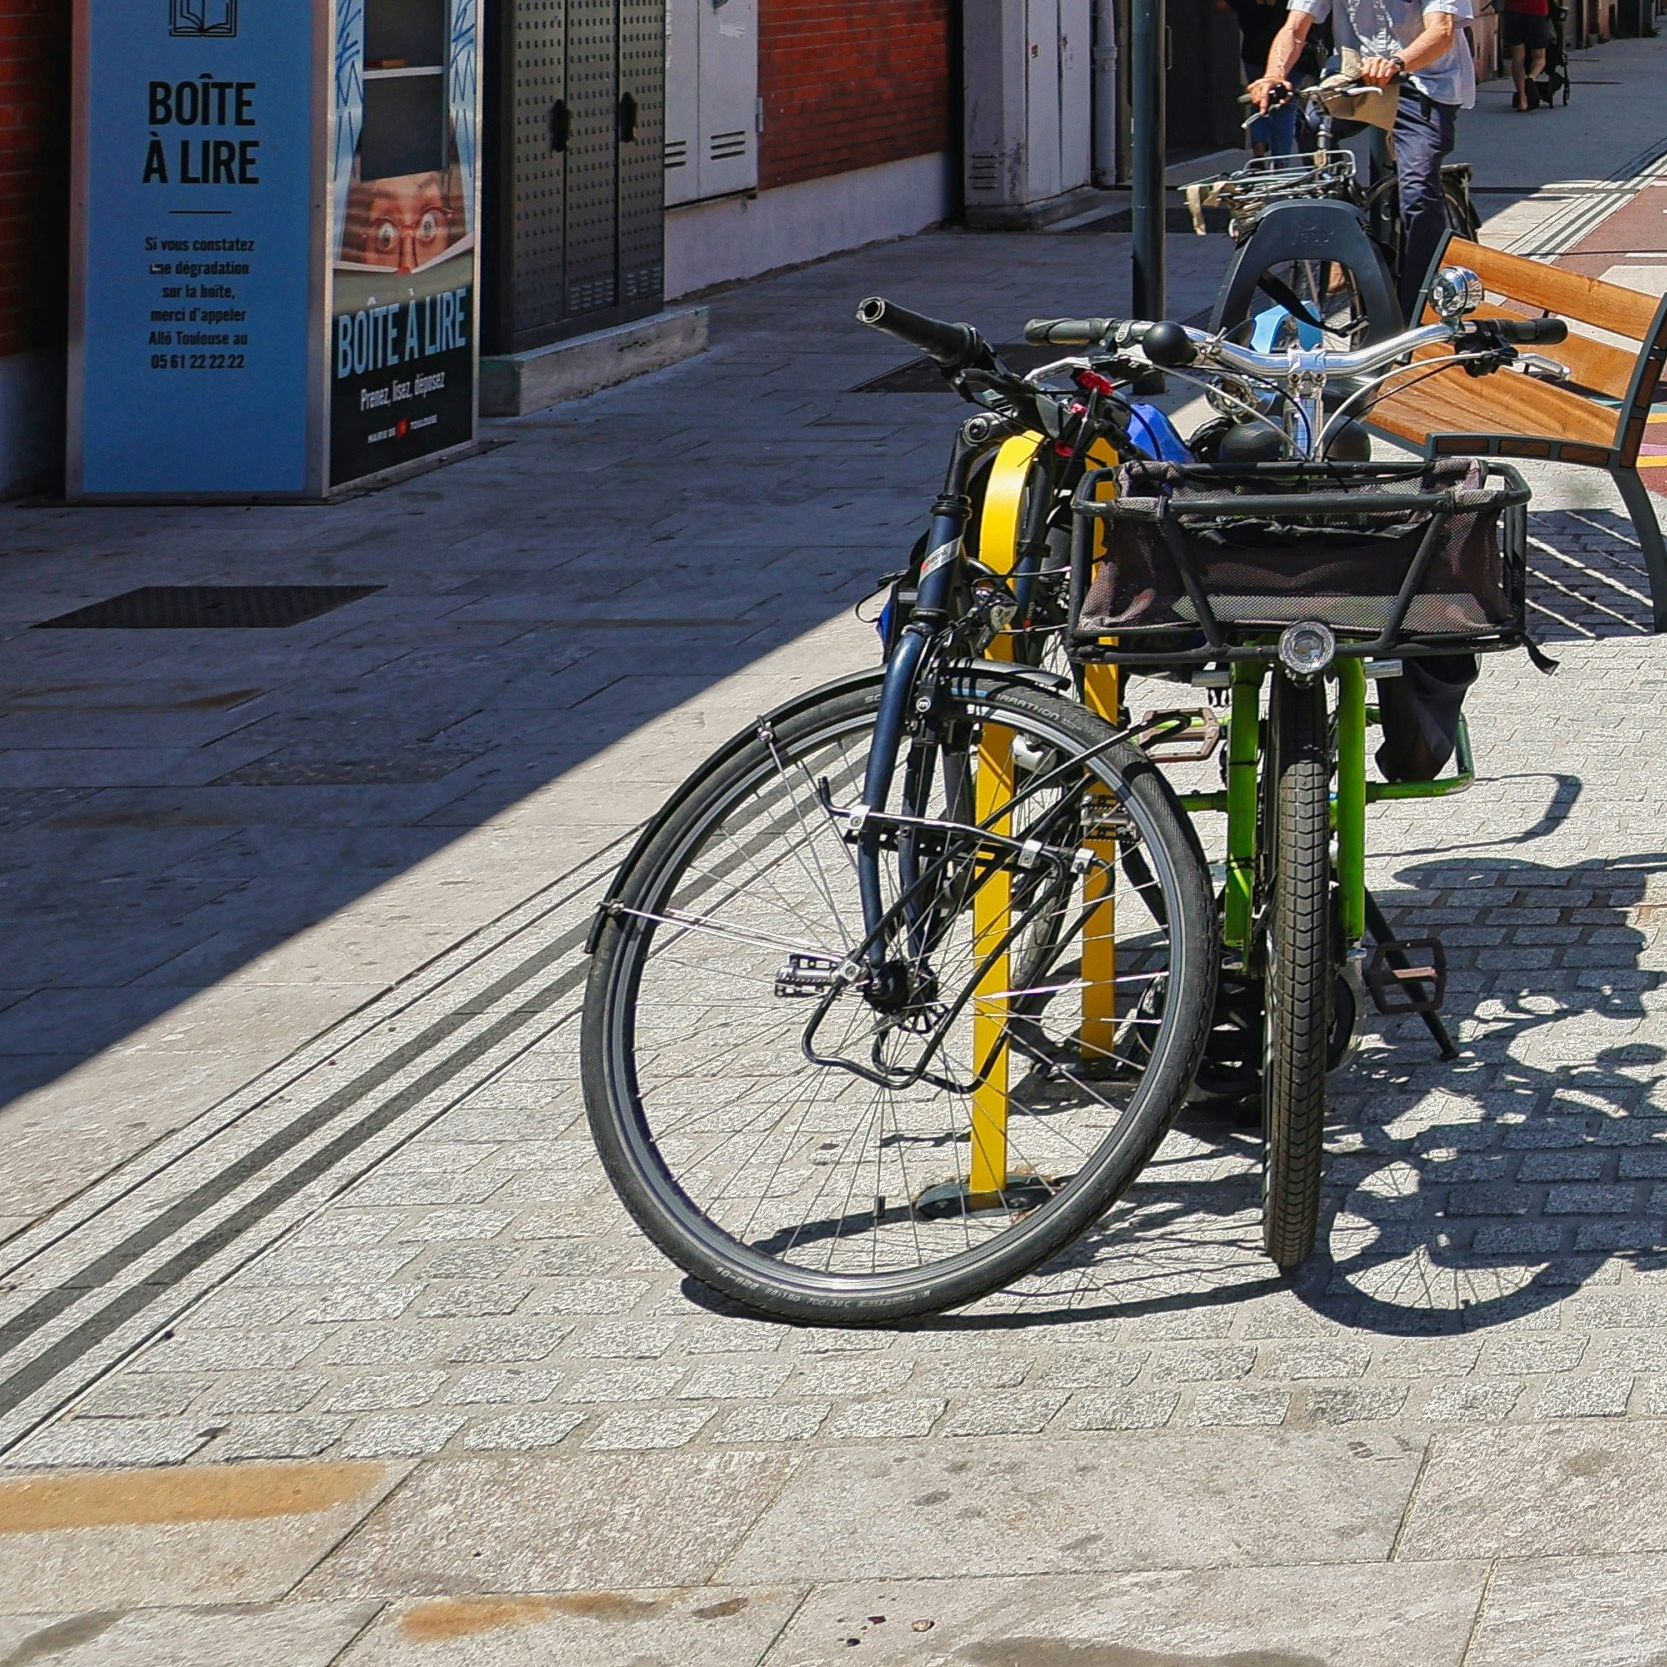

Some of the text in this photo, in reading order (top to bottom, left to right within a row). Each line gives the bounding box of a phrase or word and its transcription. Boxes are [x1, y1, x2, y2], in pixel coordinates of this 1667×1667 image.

[148, 73, 256, 126] BOÎTE
[142, 131, 260, 184] À LIRE
[144, 236, 255, 251] Si vous constatez
[175, 261, 249, 278] dégradation
[162, 284, 236, 300] sur la boîte,
[150, 307, 247, 324] merci d'appeler
[176, 331, 229, 345] Toulouse
[233, 334, 248, 345] au
[338, 288, 467, 379] BOÎTE À LIRE
[151, 354, 245, 369] 05 61 22 22 22
[360, 371, 446, 411] Prenez, lisez, déposez
